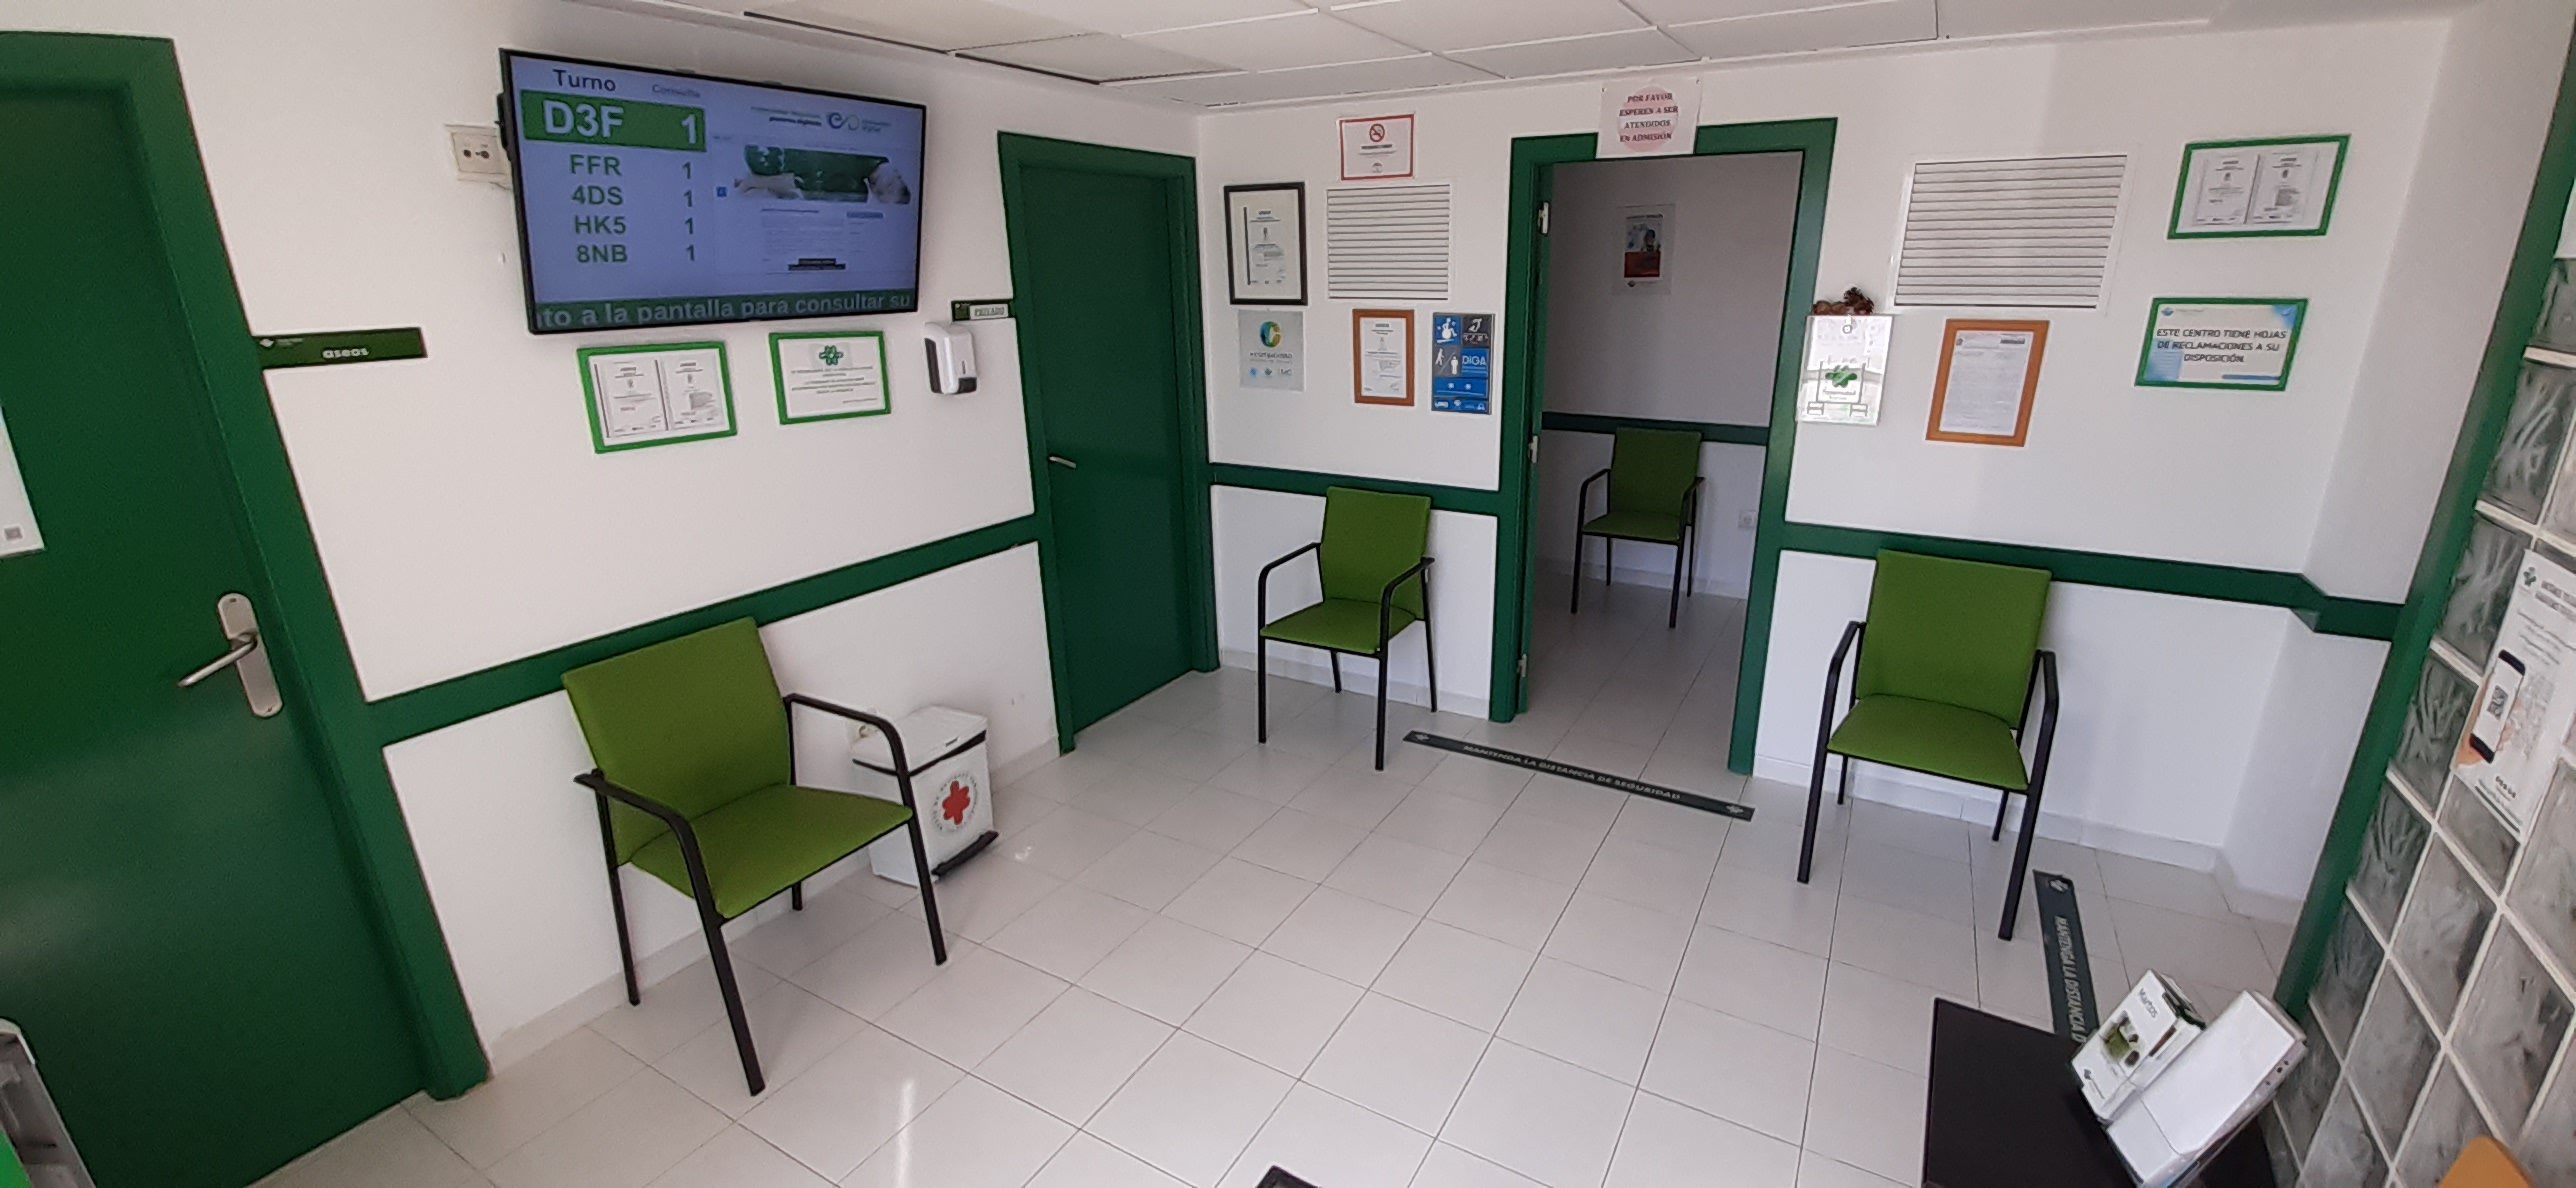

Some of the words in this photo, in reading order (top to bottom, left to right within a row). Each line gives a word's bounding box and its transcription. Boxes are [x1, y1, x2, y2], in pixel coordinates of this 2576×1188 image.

[552, 69, 616, 92] Turno
[1627, 95, 1644, 103] POR
[1645, 93, 1673, 102] FAVOR
[1619, 108, 1654, 117] ESPEREN
[1663, 105, 1679, 113] SER
[543, 99, 624, 138] D3F
[681, 113, 697, 145] 1
[1623, 119, 1672, 130] ATENDIDOS
[569, 154, 622, 176] FFR
[682, 161, 692, 180] 1
[572, 185, 624, 206] 4DS
[683, 190, 693, 208] 1
[575, 215, 628, 235] HK5
[684, 217, 694, 235] 1
[576, 244, 629, 263] 8NB
[686, 244, 696, 262] 1
[582, 309, 597, 326] a
[604, 303, 628, 323] la
[637, 299, 735, 325] pantalla
[741, 301, 789, 319] para
[795, 293, 884, 314] consultar
[889, 295, 911, 308] su
[2157, 328, 2180, 337] ESTE
[2182, 328, 2221, 338] CENTRO
[2223, 329, 2251, 339] TIENE
[2253, 330, 2287, 339] HOJAS
[322, 347, 369, 359] aseos
[2157, 340, 2170, 349] DE
[2171, 341, 2253, 350] RECLAMACIONES
[2255, 343, 2263, 351] A
[2266, 343, 2281, 352] SU
[1461, 355, 1487, 366] DIGA
[1463, 745, 1521, 764] MANTENGA
[1522, 758, 1538, 768] LA
[1539, 762, 1596, 781] DISTANCIA
[1597, 775, 1613, 785] DE
[1614, 779, 1682, 800] SEGURIDAD
[2055, 916, 2076, 965] MANTENGA
[2063, 965, 2077, 978] LA
[2065, 979, 2085, 1030] DISTANCIA
